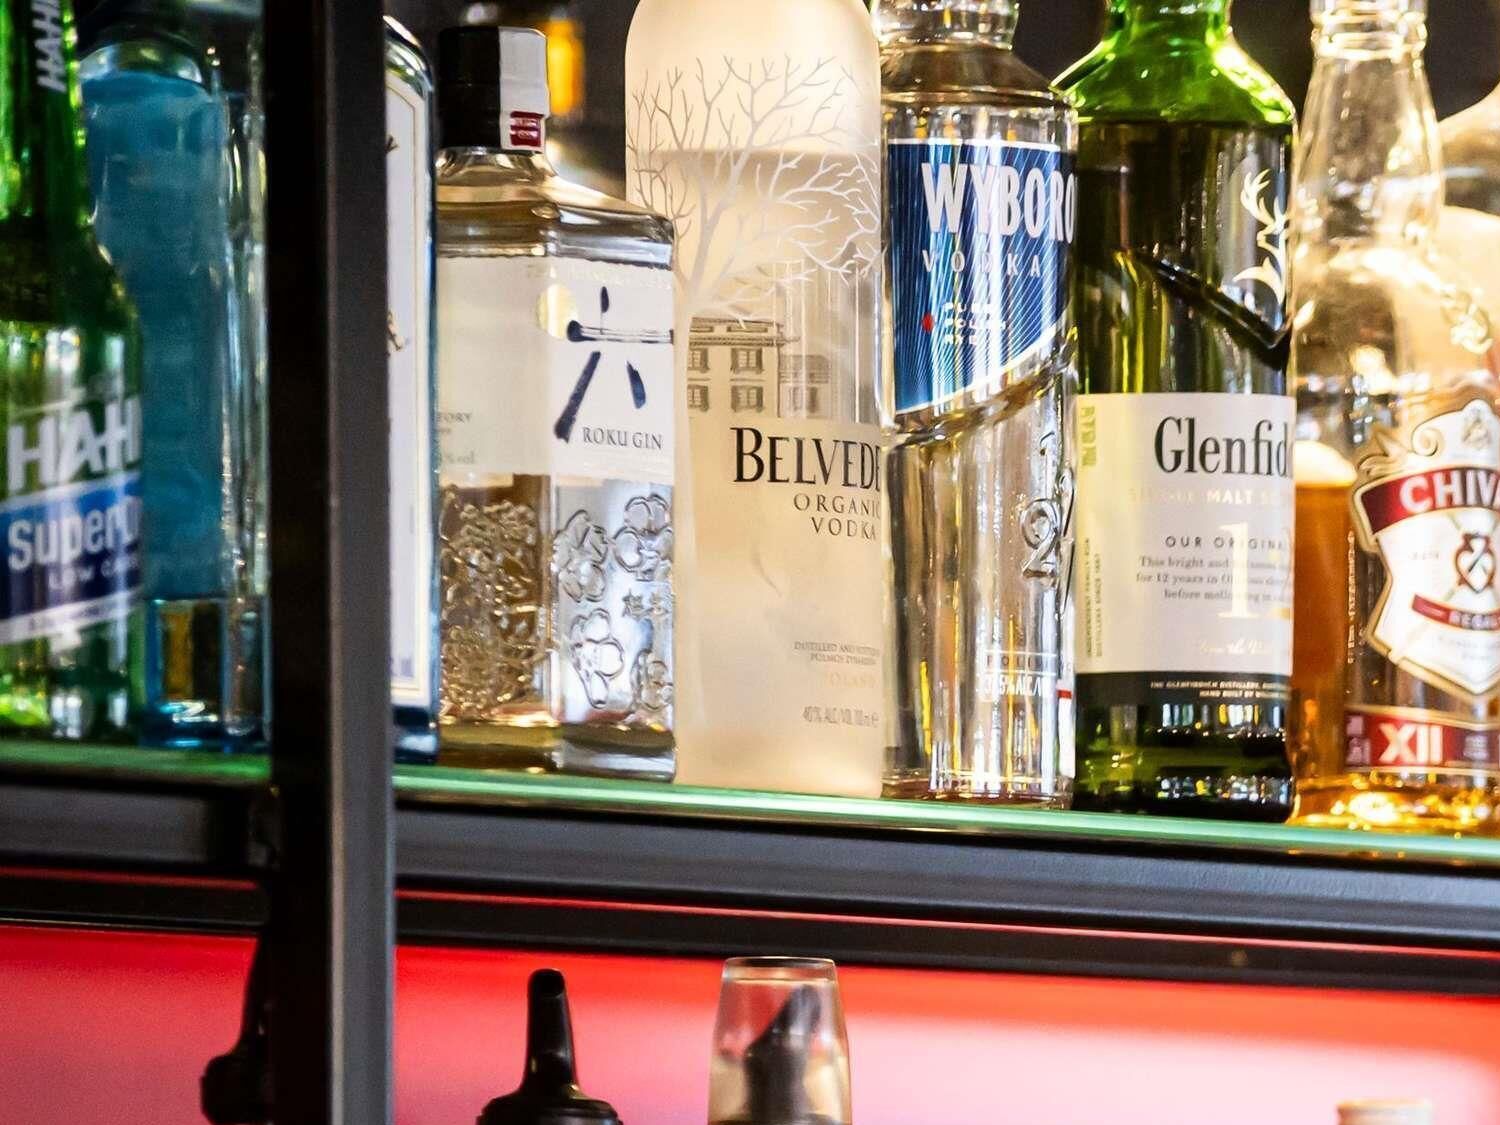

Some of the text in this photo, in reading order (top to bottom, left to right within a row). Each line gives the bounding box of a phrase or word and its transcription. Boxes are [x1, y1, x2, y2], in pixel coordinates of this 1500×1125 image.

[922, 249, 1041, 278] VODKA
[582, 426, 662, 450] ROKU GIN
[811, 516, 876, 540] VODKA
[1165, 536, 1202, 548] OUR
